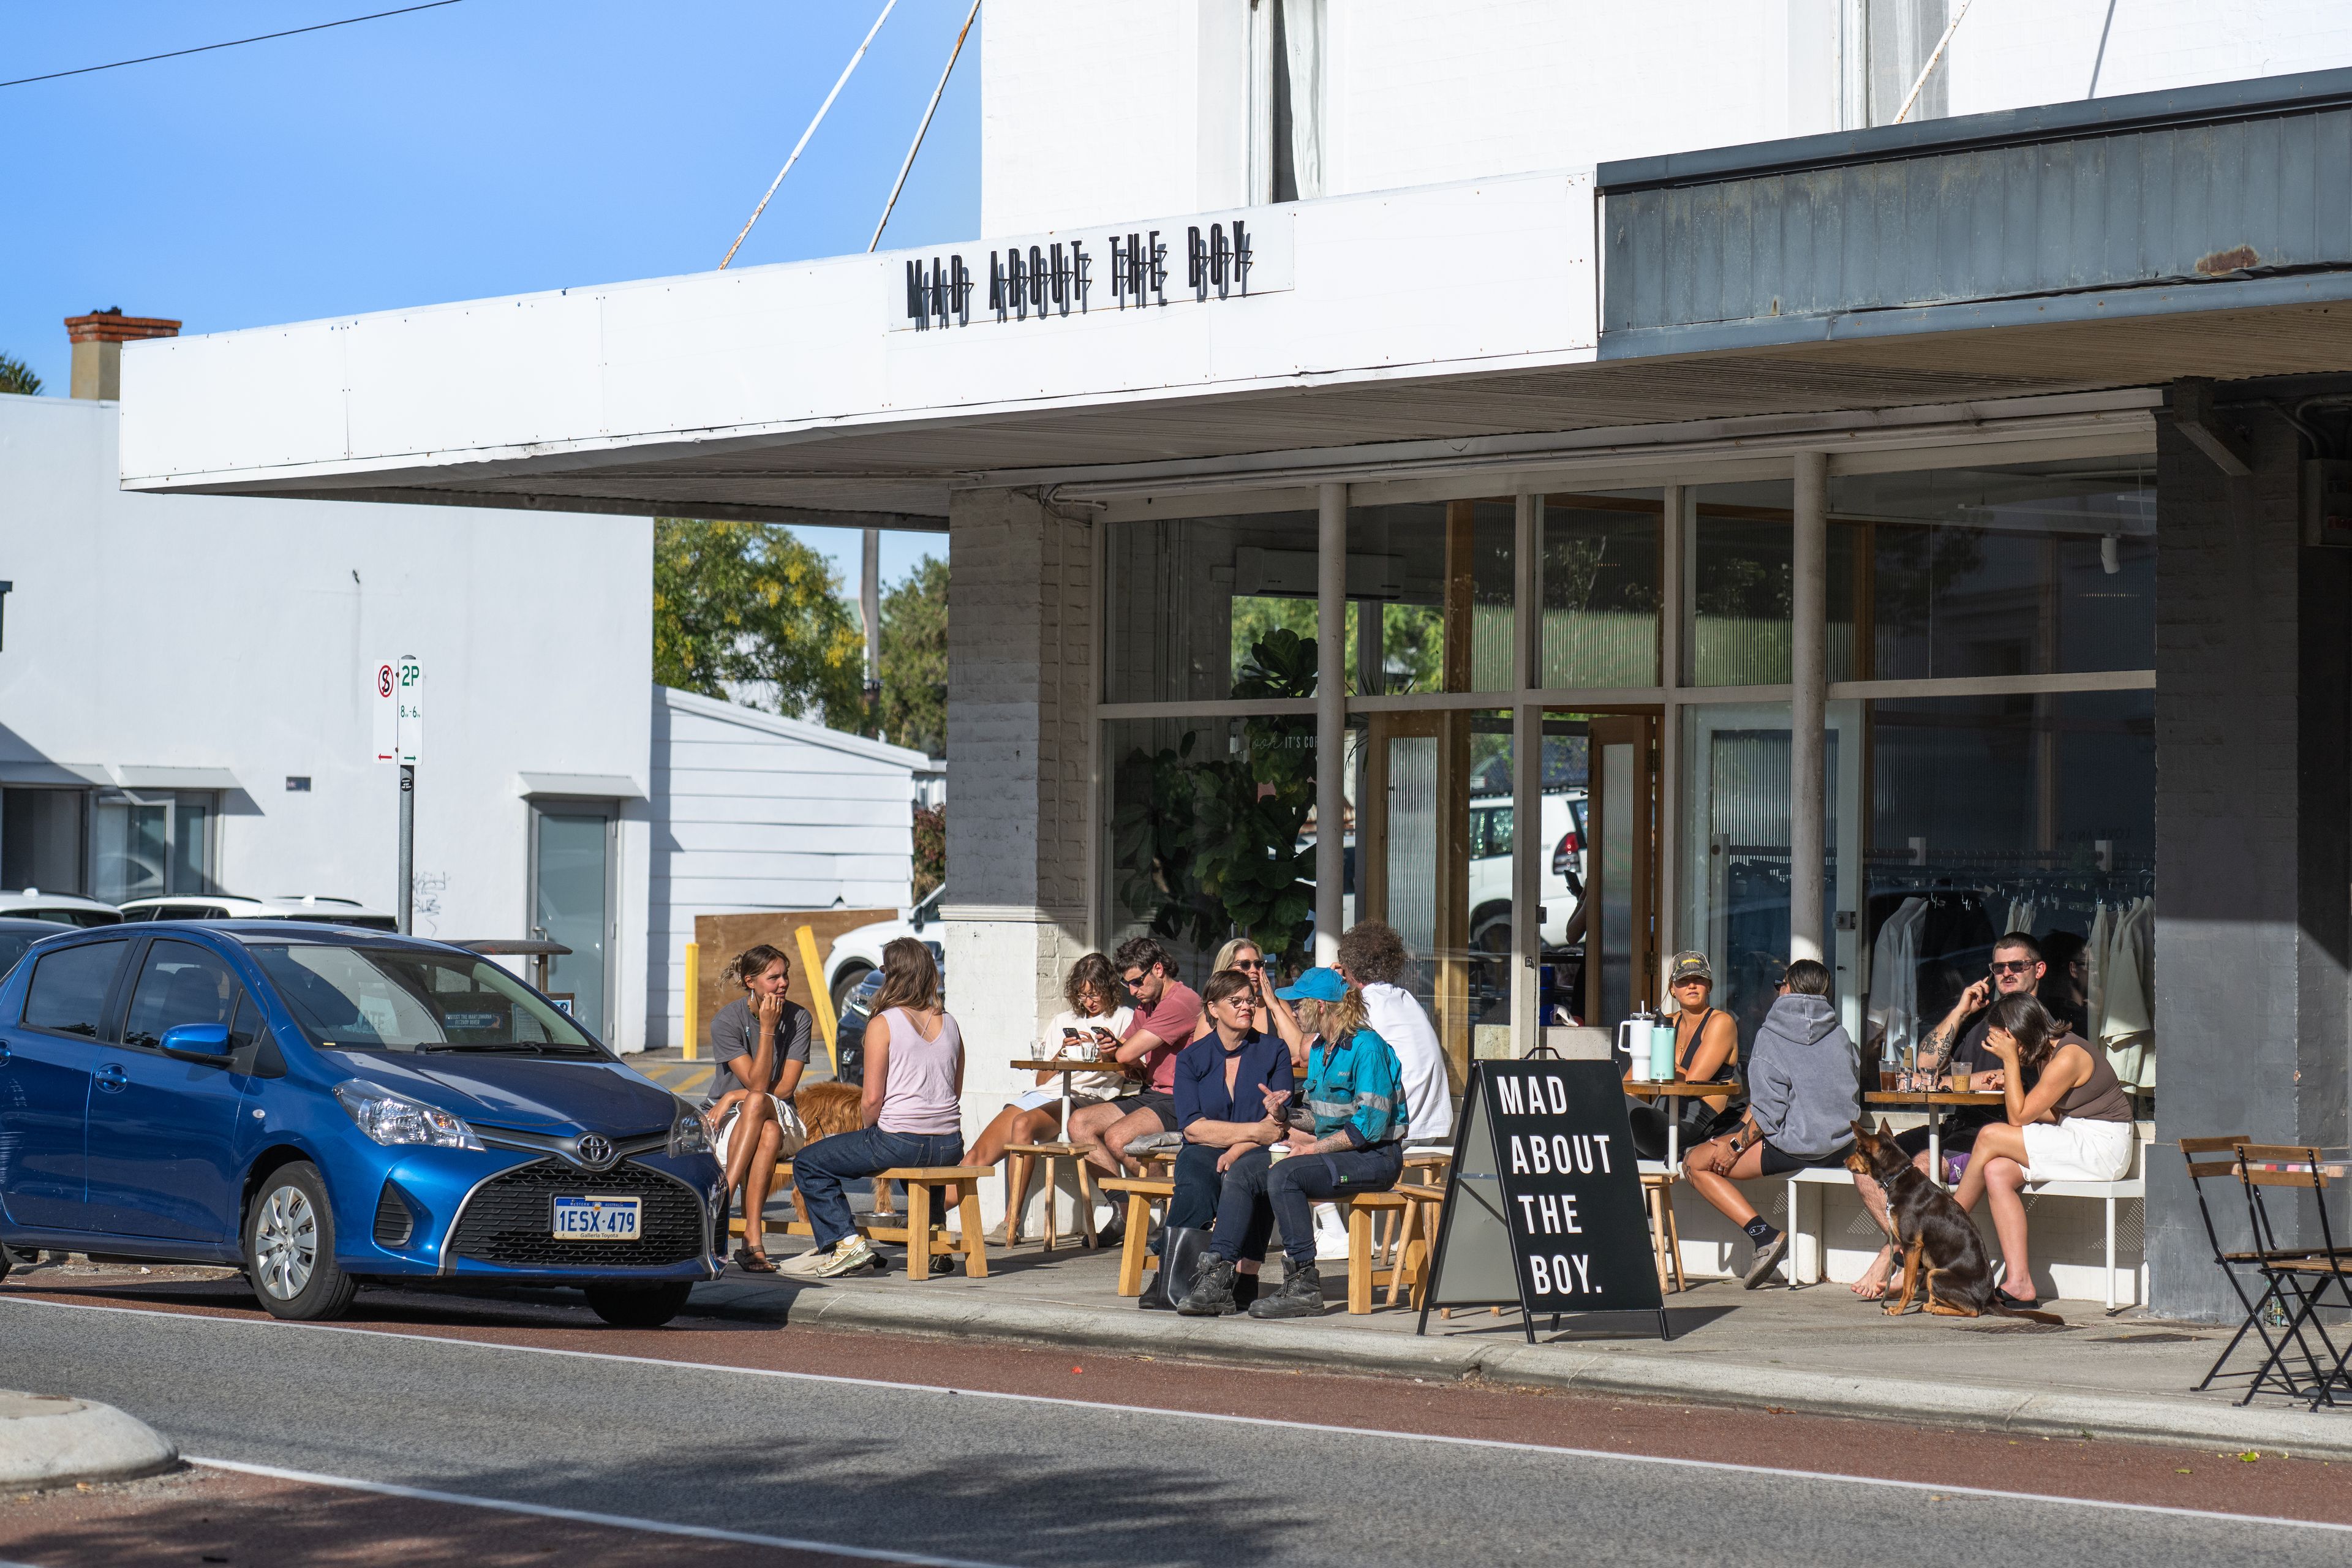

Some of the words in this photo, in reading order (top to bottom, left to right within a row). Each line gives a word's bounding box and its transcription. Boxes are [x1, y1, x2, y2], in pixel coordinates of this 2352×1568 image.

[907, 255, 963, 318] MAD
[989, 240, 1082, 309] ABOUT
[1109, 230, 1161, 296] THE
[1188, 221, 1245, 287] BOY
[401, 665, 420, 687] 2P
[1251, 731, 1283, 750] ooh
[1285, 736, 1300, 748] IT'S
[1496, 1076, 1567, 1114] MAD
[1511, 1135, 1610, 1175] ABOUT
[1517, 1195, 1582, 1234] THE
[1529, 1254, 1602, 1294] BOY.
